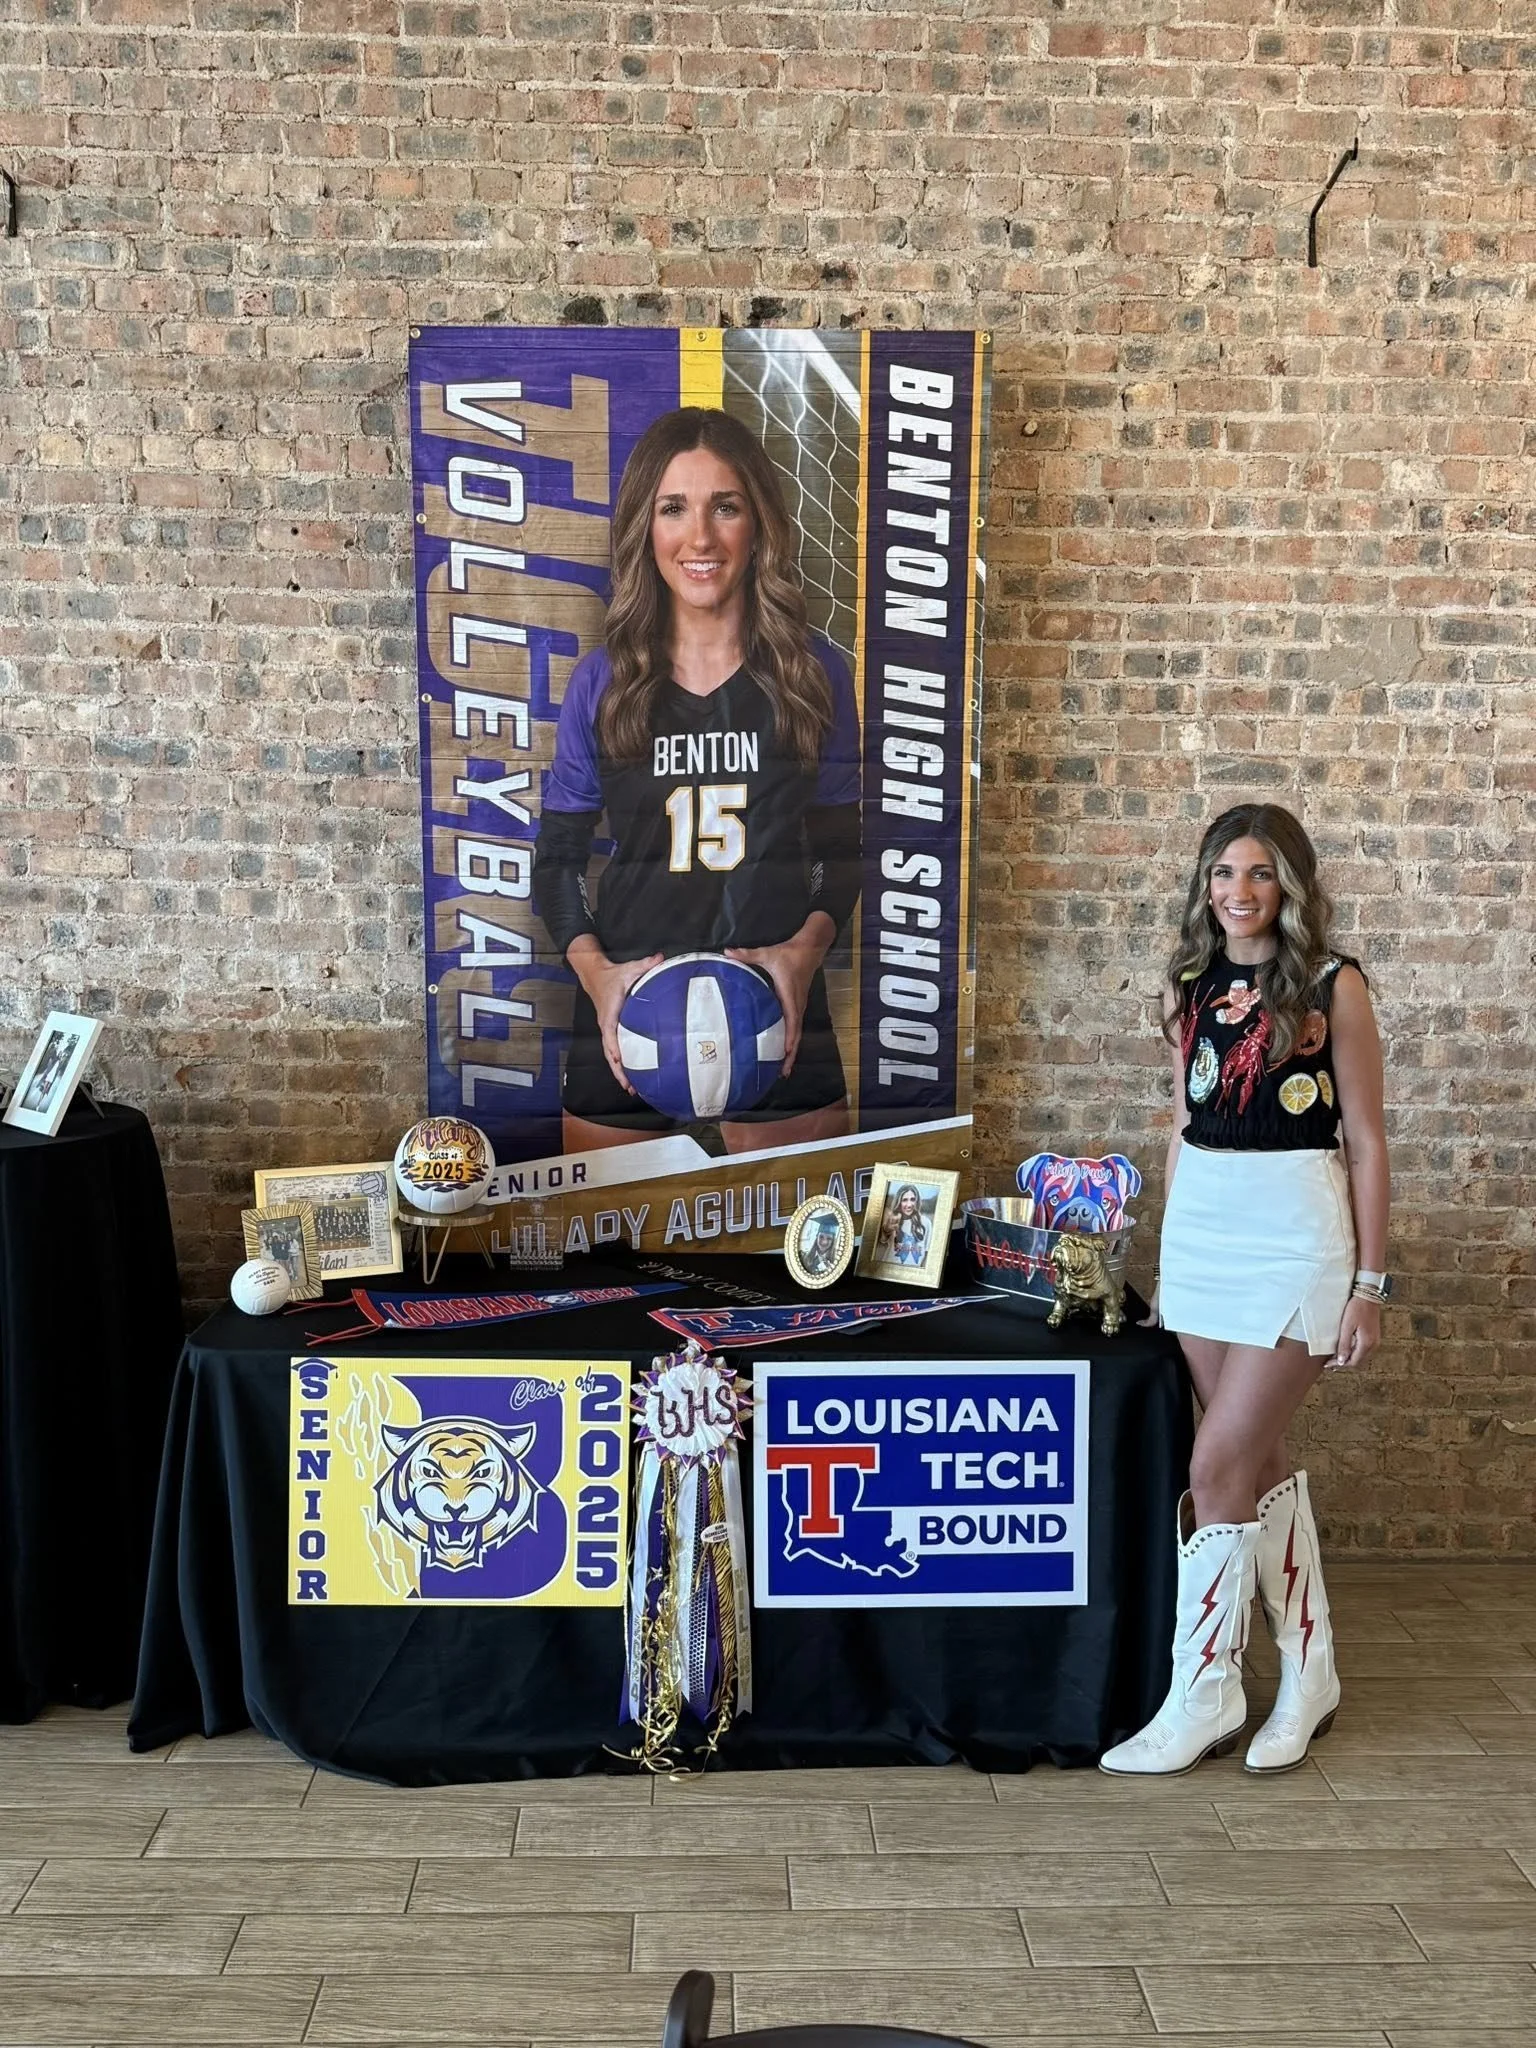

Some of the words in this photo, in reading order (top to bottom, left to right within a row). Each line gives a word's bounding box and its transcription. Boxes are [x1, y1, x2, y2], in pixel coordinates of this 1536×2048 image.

[885, 363, 954, 639] BENTON
[443, 380, 534, 1107] VOLLEYBALL
[653, 731, 759, 777] BENTON
[880, 663, 947, 823] HIGH
[665, 783, 748, 873] 15
[877, 848, 944, 1086] SCHOOL
[422, 1162, 464, 1180] 2025
[487, 1162, 587, 1198] ENIOR
[663, 1160, 910, 1246] AGUILLAR
[380, 1294, 553, 1327] LOUISIANA
[575, 1287, 640, 1304] TECH
[510, 1378, 567, 1411] Class
[575, 1366, 599, 1393] of
[787, 1396, 1059, 1435] LOUISIANA
[295, 1366, 332, 1601] SENIOR
[575, 1373, 623, 1591] 2025
[920, 1450, 1059, 1490] TECH
[919, 1513, 1068, 1546] BOUND
